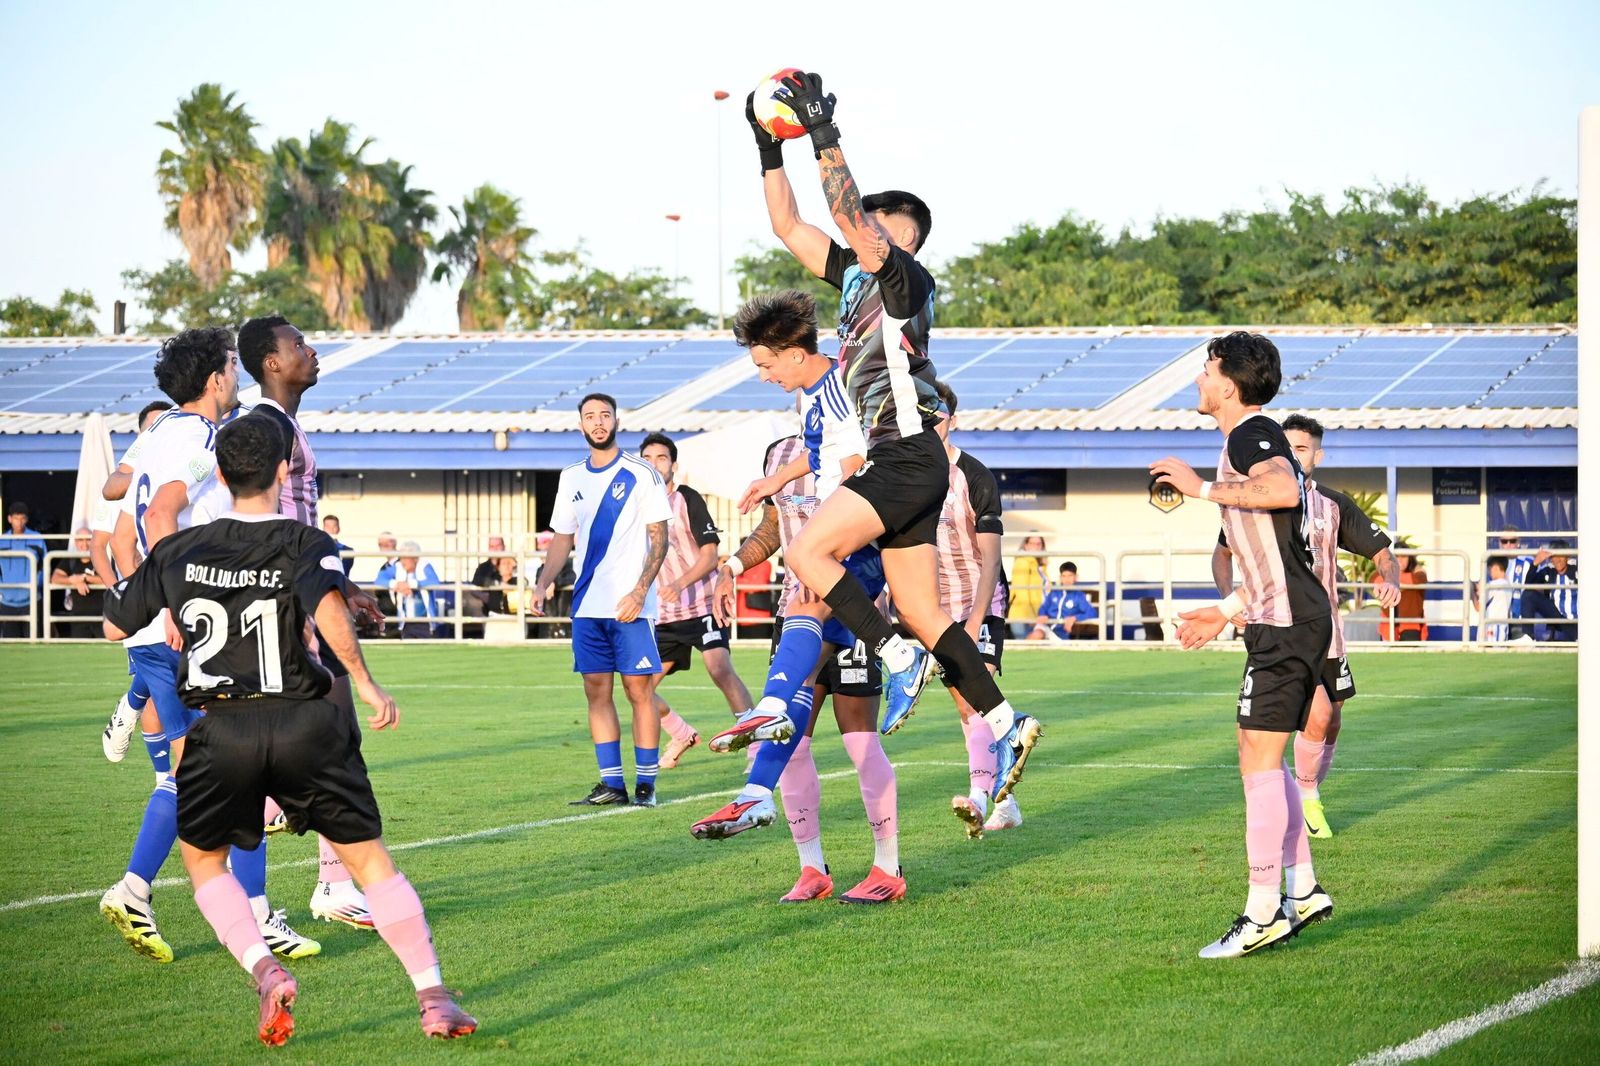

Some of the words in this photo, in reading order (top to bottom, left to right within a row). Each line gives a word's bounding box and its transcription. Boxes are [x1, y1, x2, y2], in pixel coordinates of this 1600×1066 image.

[185, 563, 258, 588] BOLLULLOS
[259, 569, 284, 589] C.F.
[179, 597, 283, 693] 21
[837, 638, 868, 667] 24
